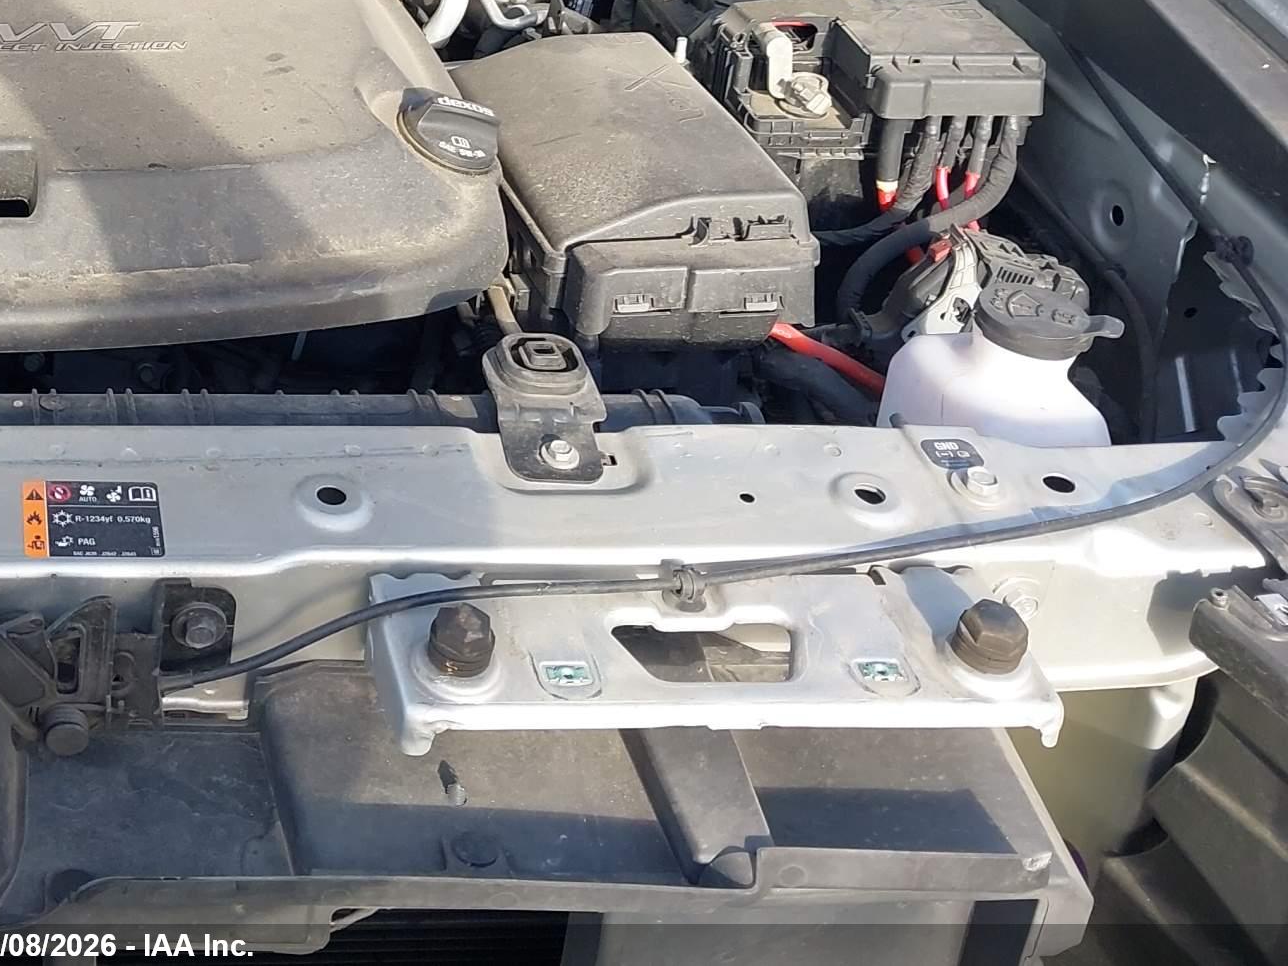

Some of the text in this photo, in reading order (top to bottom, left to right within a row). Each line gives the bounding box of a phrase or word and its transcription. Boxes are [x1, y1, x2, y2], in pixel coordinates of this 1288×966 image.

[54, 40, 189, 52] INJECTION
[74, 515, 151, 524] R-1234yf 0.570kg
[77, 537, 96, 546] PAG
